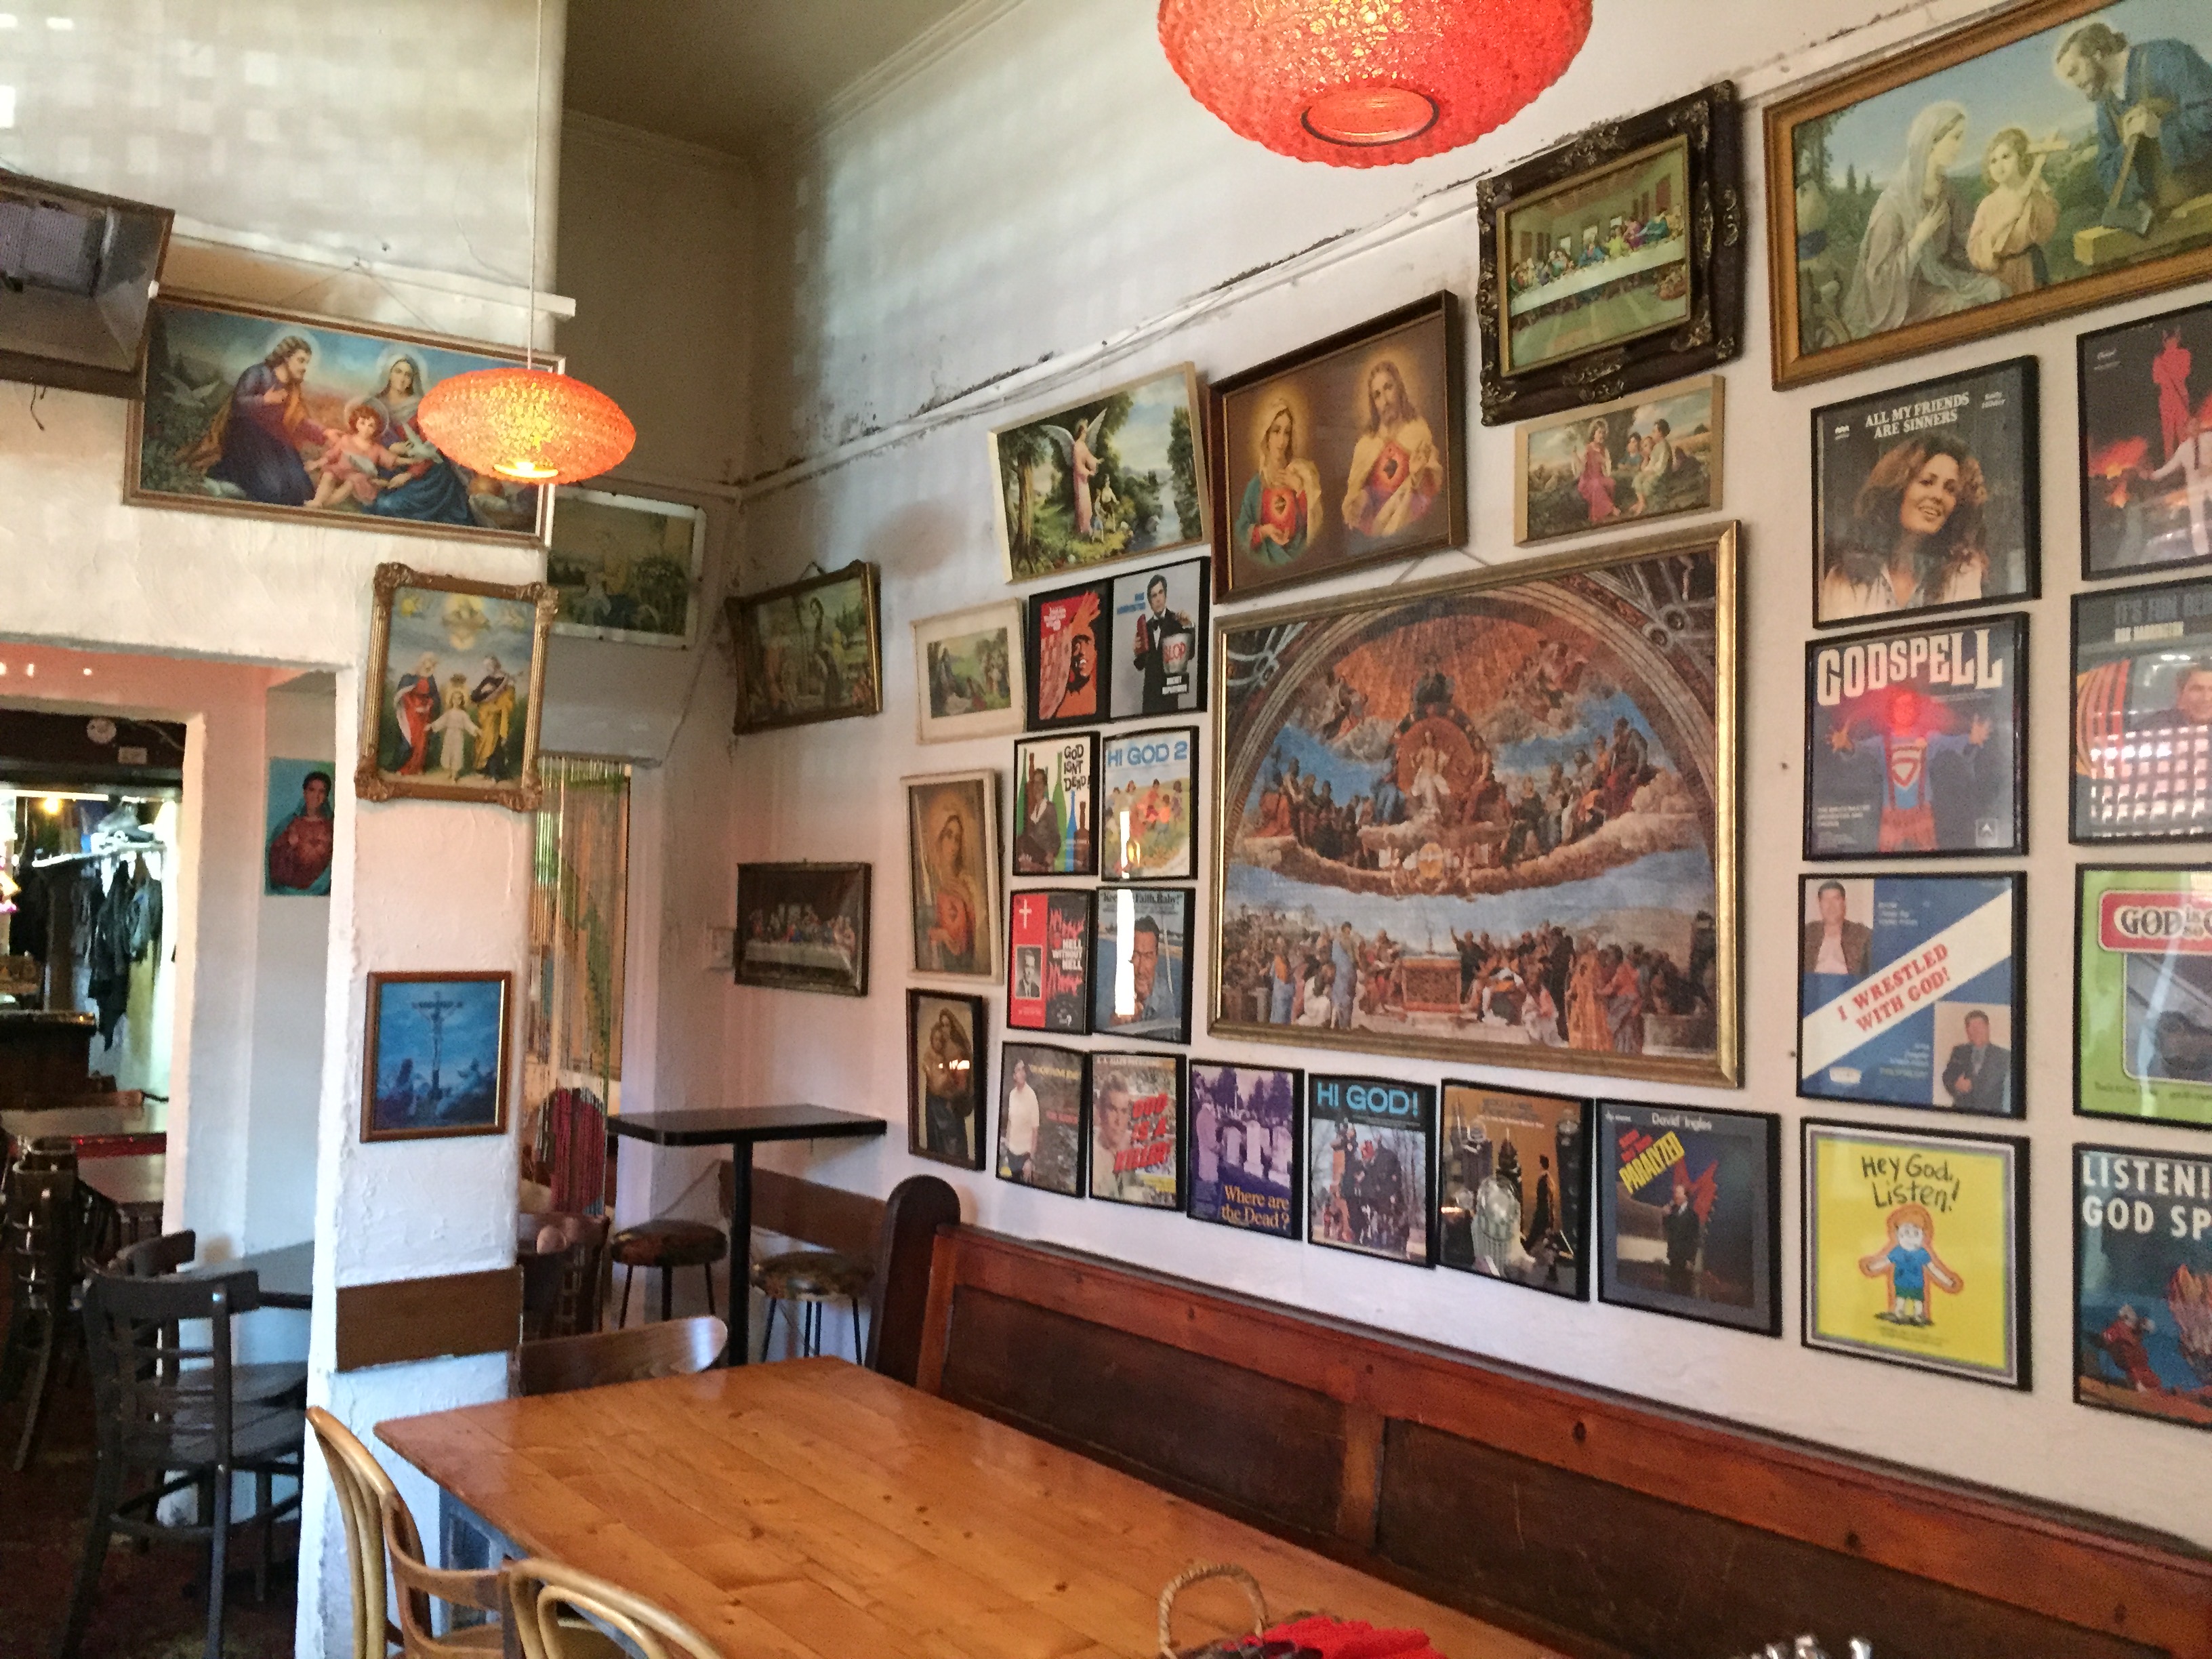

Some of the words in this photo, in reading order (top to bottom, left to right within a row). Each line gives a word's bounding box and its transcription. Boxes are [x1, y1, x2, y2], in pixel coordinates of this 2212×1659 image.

[1866, 411, 1889, 427] ALL
[1892, 406, 1913, 422] MY
[1914, 392, 1970, 417] FRIENDS
[1874, 422, 1900, 439] ARE
[1903, 409, 1958, 433] SINNERS
[1817, 628, 2004, 707] GODSPELL
[1064, 743, 1084, 760] GOD
[1107, 747, 1123, 767] HI
[1127, 743, 1170, 765] GOD
[1174, 740, 1188, 760] 2
[2121, 908, 2183, 936] GOD
[1837, 1005, 1848, 1021] I
[1852, 943, 1948, 1009] WRESTLED
[1856, 995, 1905, 1031] WITH
[1908, 966, 1950, 1002] GOD!
[1317, 1082, 1339, 1108] HI
[1347, 1085, 1418, 1118] GOD!
[1652, 1112, 1680, 1127] David
[1618, 1130, 1685, 1195] PARALYZED
[2083, 1154, 2211, 1200] LISTEN!
[1225, 1185, 1265, 1207] Where
[1268, 1195, 1290, 1211] are
[1872, 1178, 1960, 1213] Listen!
[1221, 1203, 1242, 1224] the
[2083, 1195, 2154, 1233] GOD
[2171, 1204, 2212, 1242] SP
